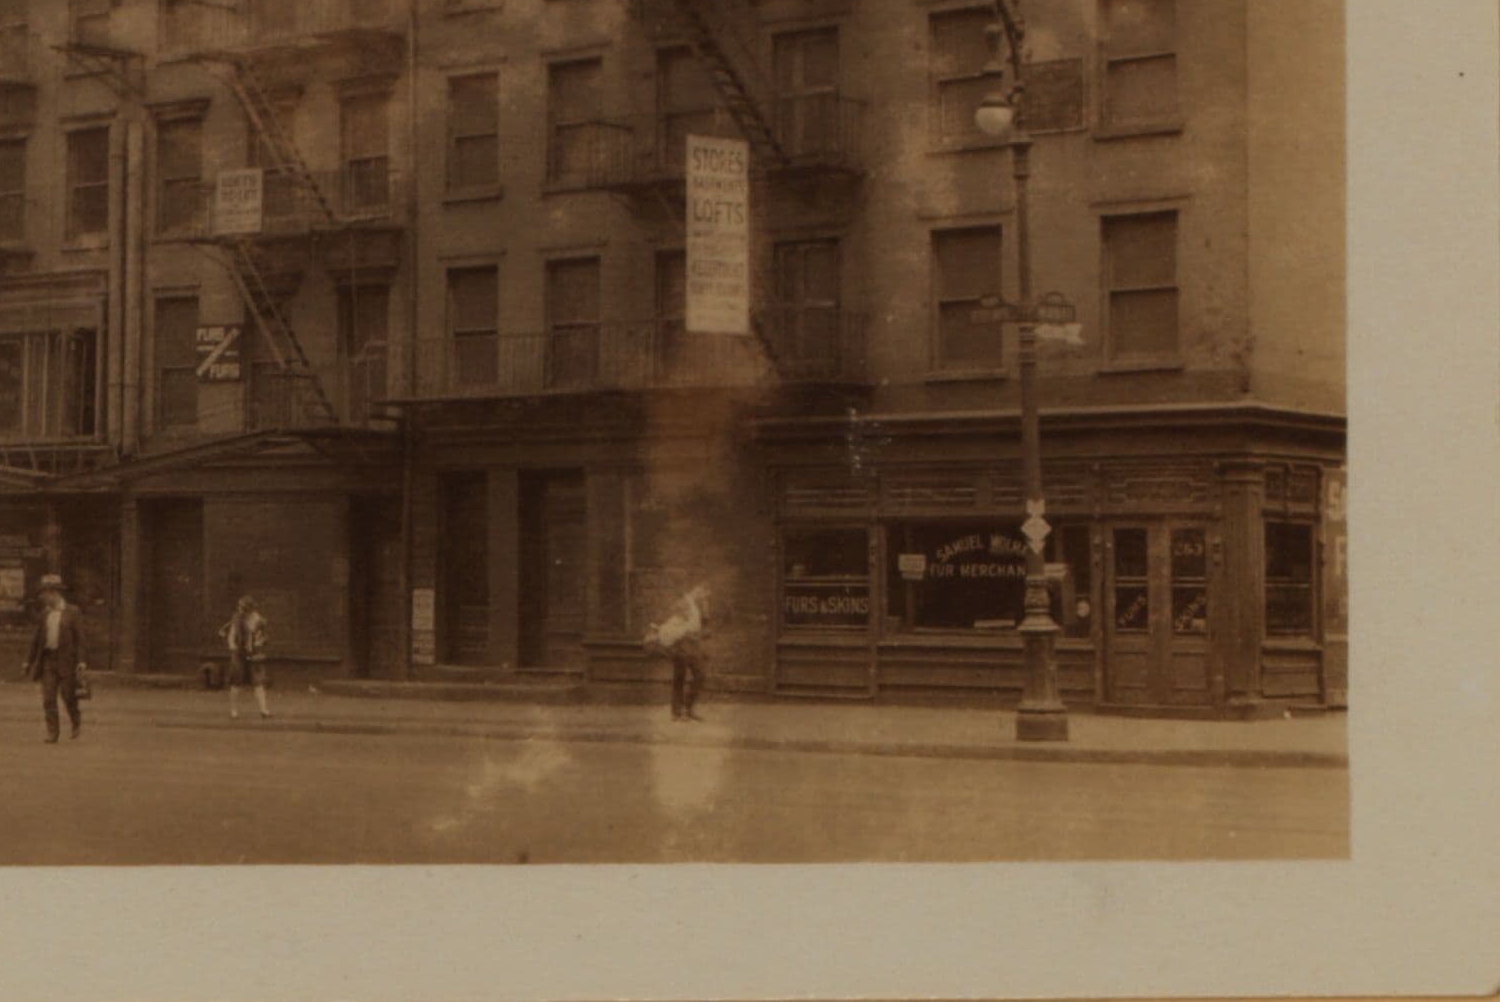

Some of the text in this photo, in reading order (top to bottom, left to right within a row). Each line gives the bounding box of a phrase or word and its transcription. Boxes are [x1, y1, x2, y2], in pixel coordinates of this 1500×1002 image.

[693, 198, 744, 224] LOFTS
[935, 533, 985, 563] SAMUEL
[930, 563, 1026, 578] FUR MERCHAN
[786, 596, 817, 614] FURS
[828, 597, 869, 614] SKINS
